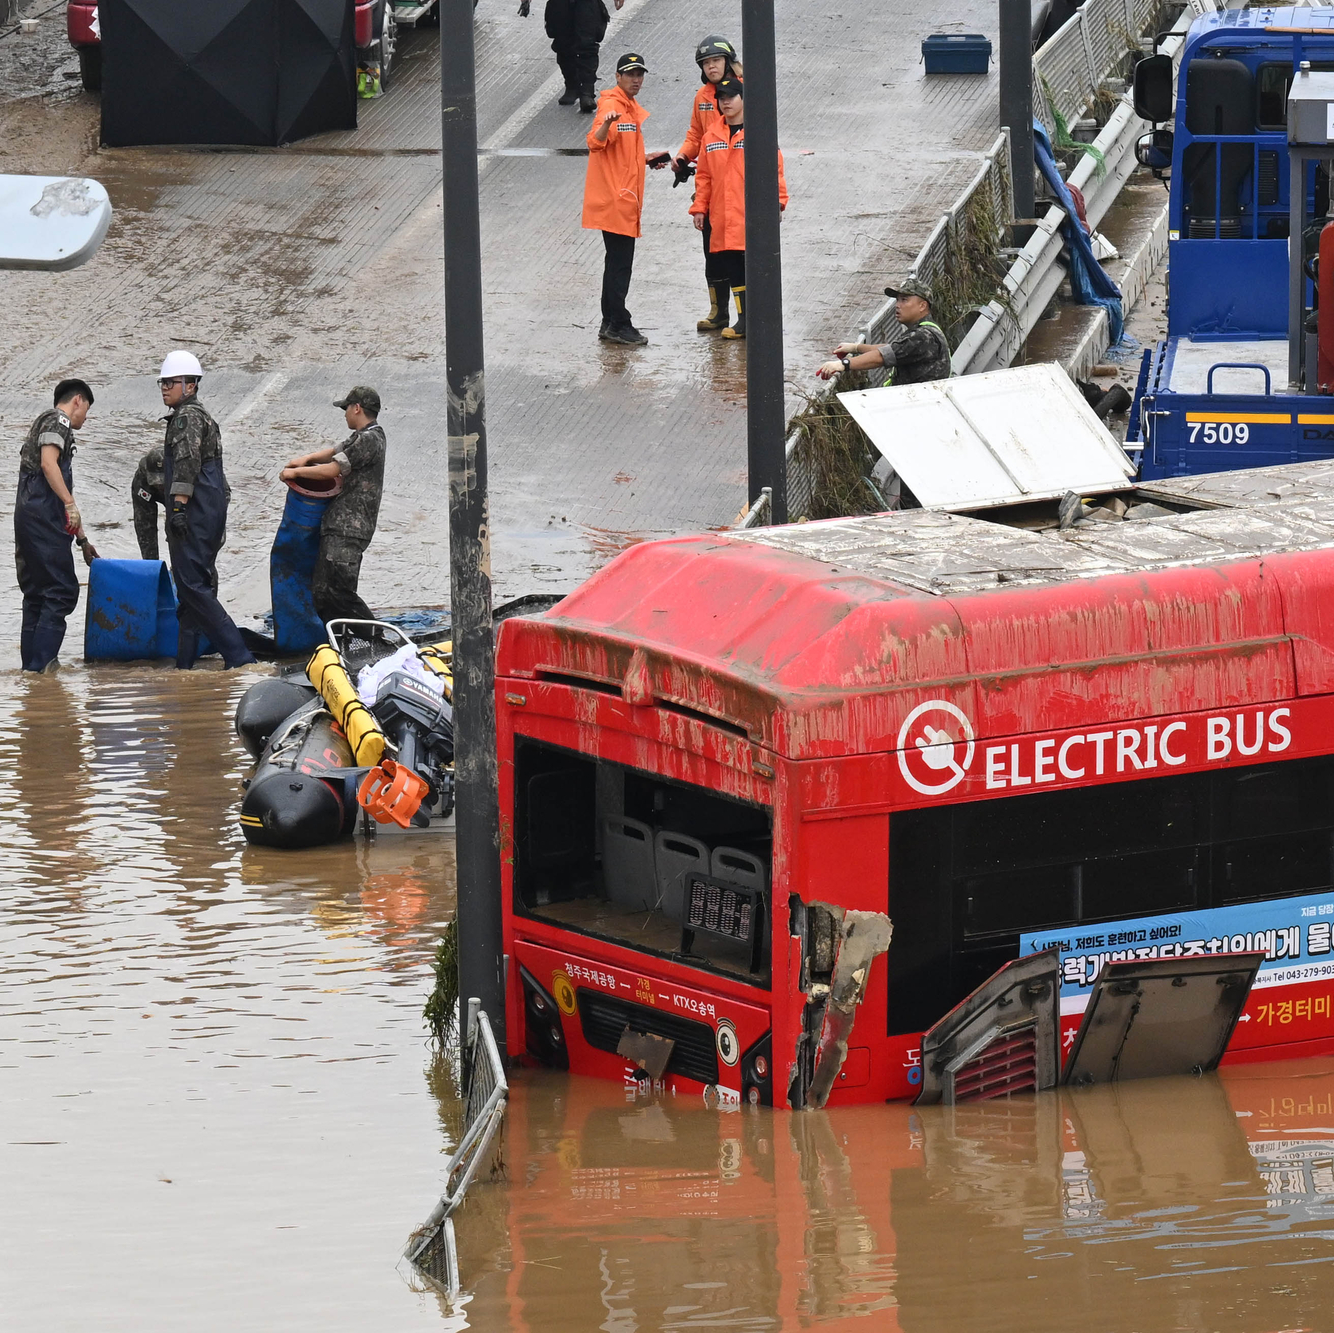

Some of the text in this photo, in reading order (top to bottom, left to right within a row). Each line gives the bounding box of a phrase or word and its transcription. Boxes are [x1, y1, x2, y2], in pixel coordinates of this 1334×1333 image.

[1186, 422, 1250, 444] 7509
[411, 682, 444, 705] YAMAHA
[985, 708, 1292, 790] ELECTRIC BUS
[1300, 906, 1317, 918] 지금
[1318, 904, 1334, 916] 당장
[1075, 935, 1105, 950] 저희도
[1107, 929, 1147, 946] 훈련하고
[1149, 924, 1182, 940] 싶어요!
[565, 962, 616, 990] 청주국제공항
[1273, 971, 1285, 982] Tel
[673, 993, 716, 1019] KTX오송역
